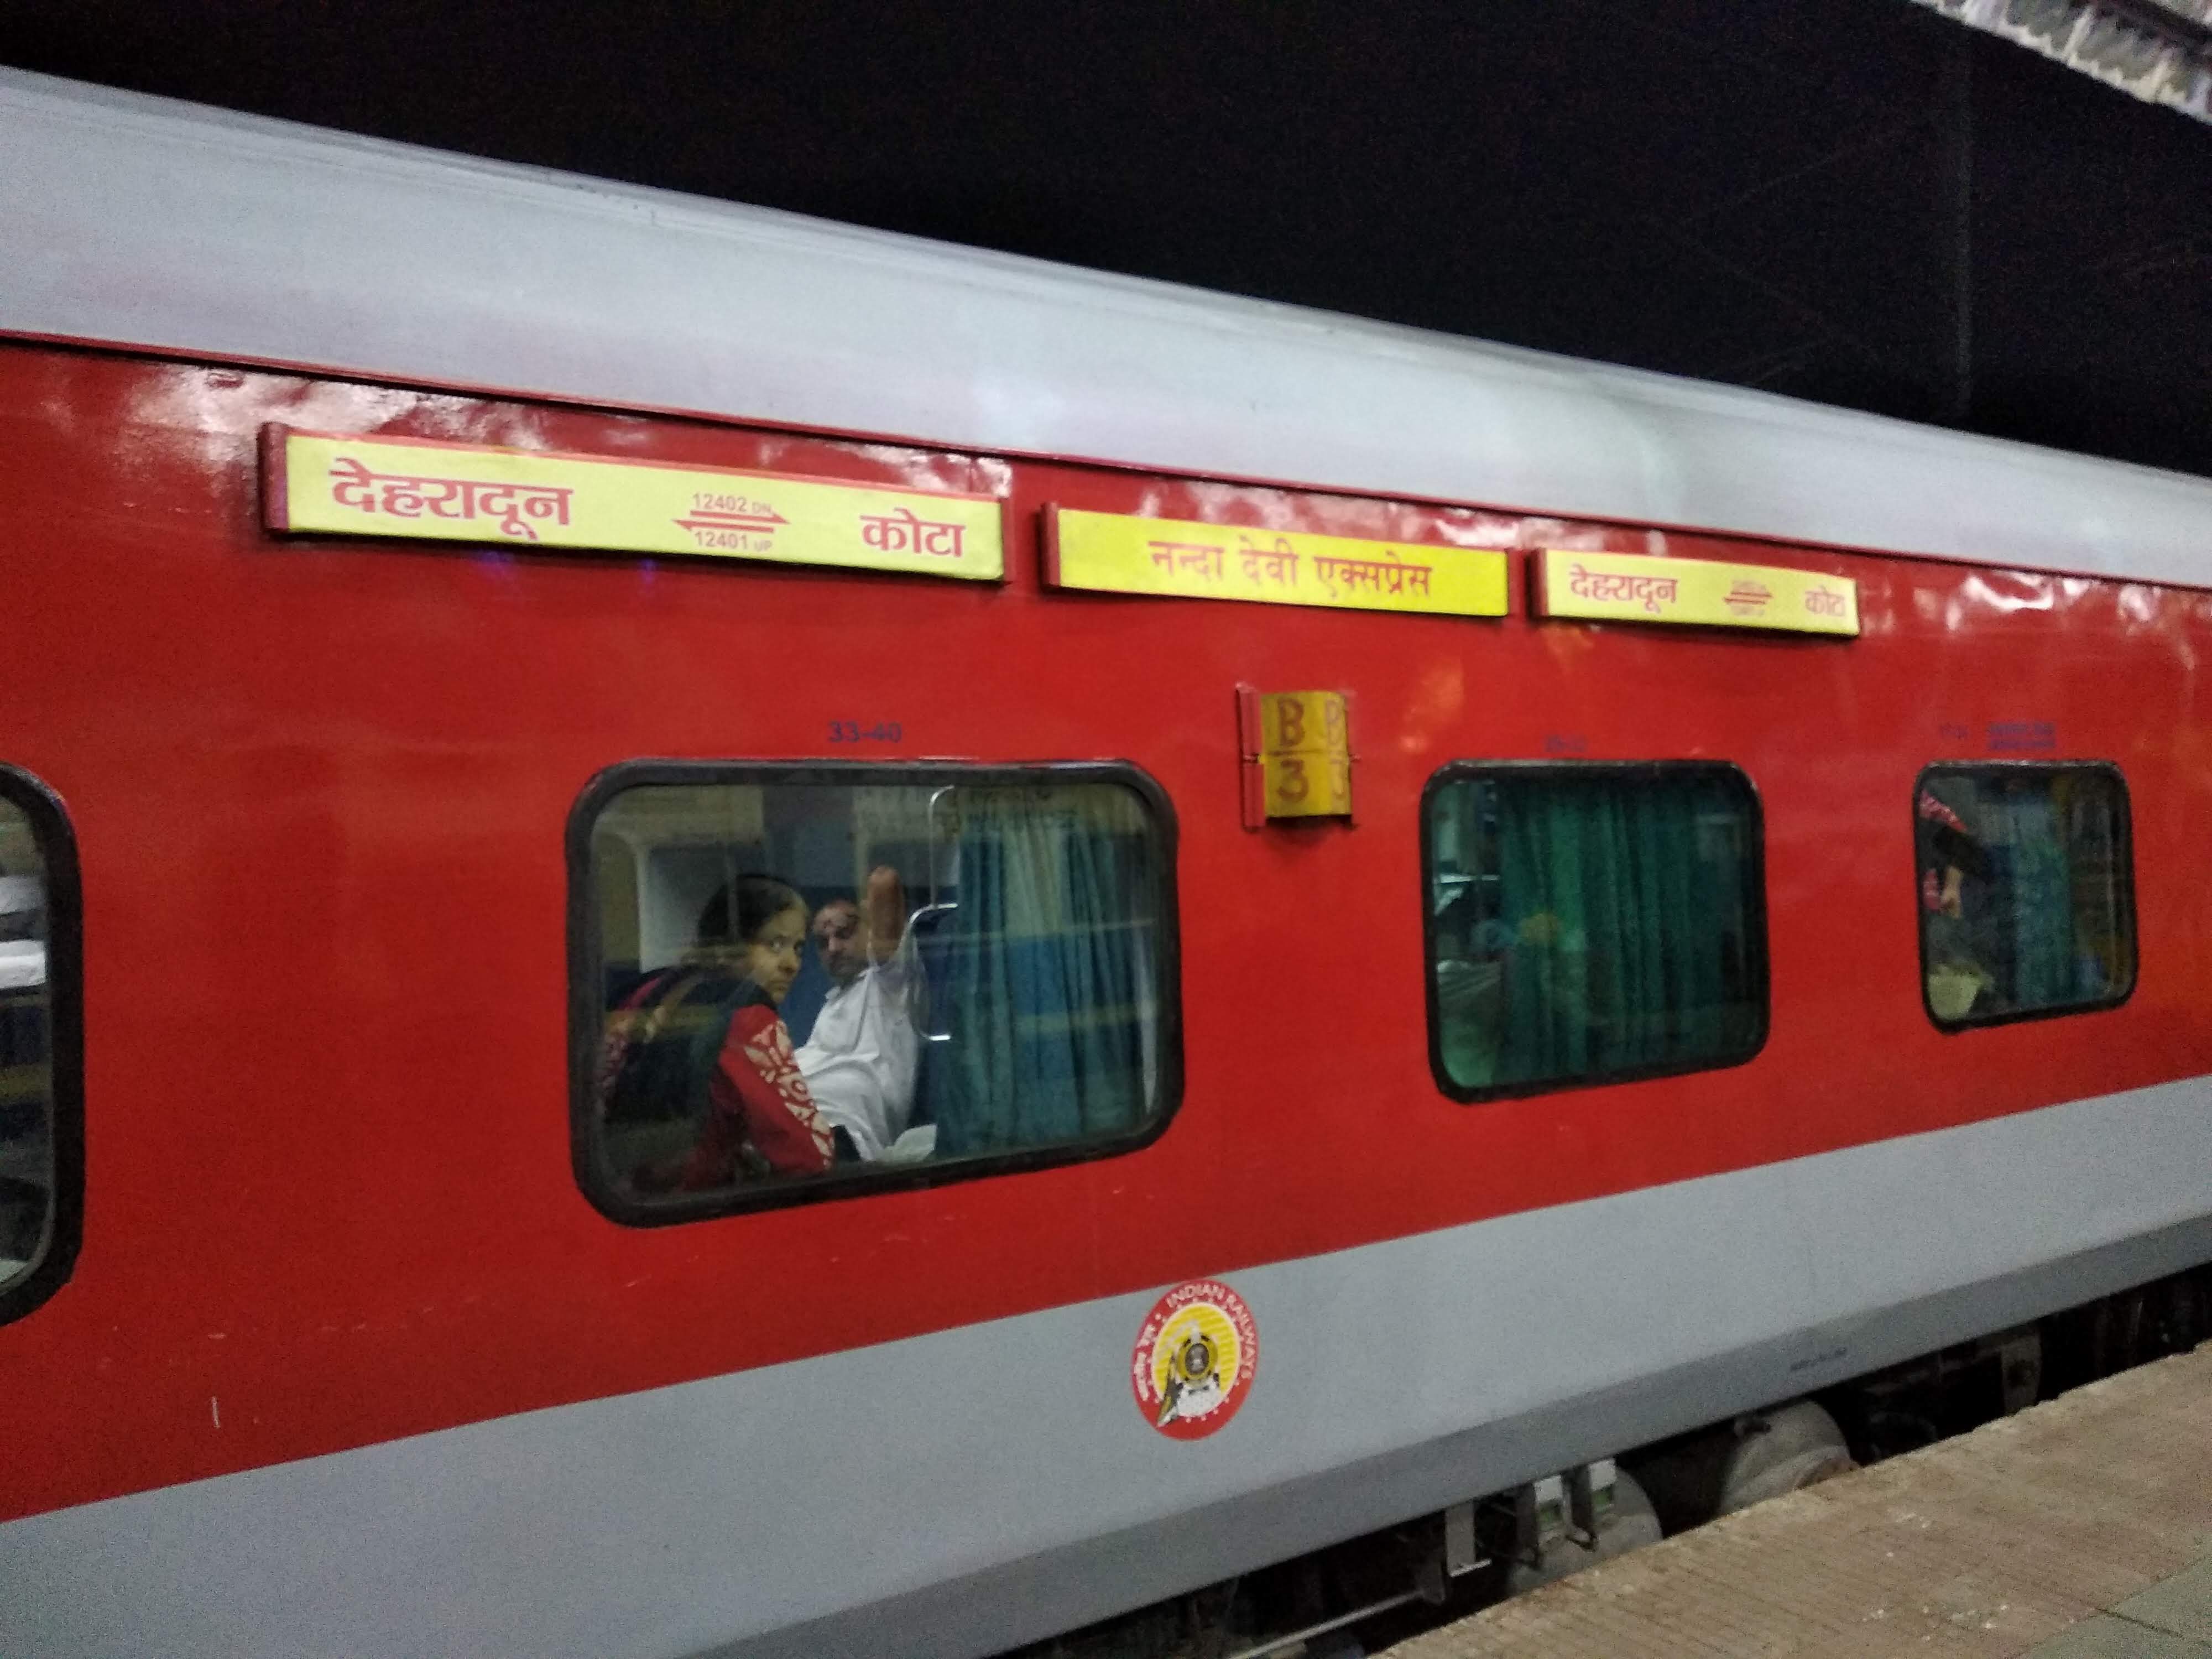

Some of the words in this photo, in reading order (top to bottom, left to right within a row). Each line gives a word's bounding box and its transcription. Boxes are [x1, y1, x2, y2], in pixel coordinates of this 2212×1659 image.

[328, 457, 574, 541] देहरादून
[693, 493, 747, 512] 12402
[695, 531, 748, 549] 12401
[860, 508, 966, 557] कोटा
[1148, 541, 1224, 580] नन्दा
[1239, 535, 1299, 586] देवी
[1313, 550, 1432, 598] एक्सप्रेस
[1569, 564, 1677, 614] देहरादून
[828, 721, 902, 742] 33-40
[1278, 698, 1305, 746] B
[1278, 759, 1309, 801] 3
[1165, 1284, 1225, 1308] INDIAN
